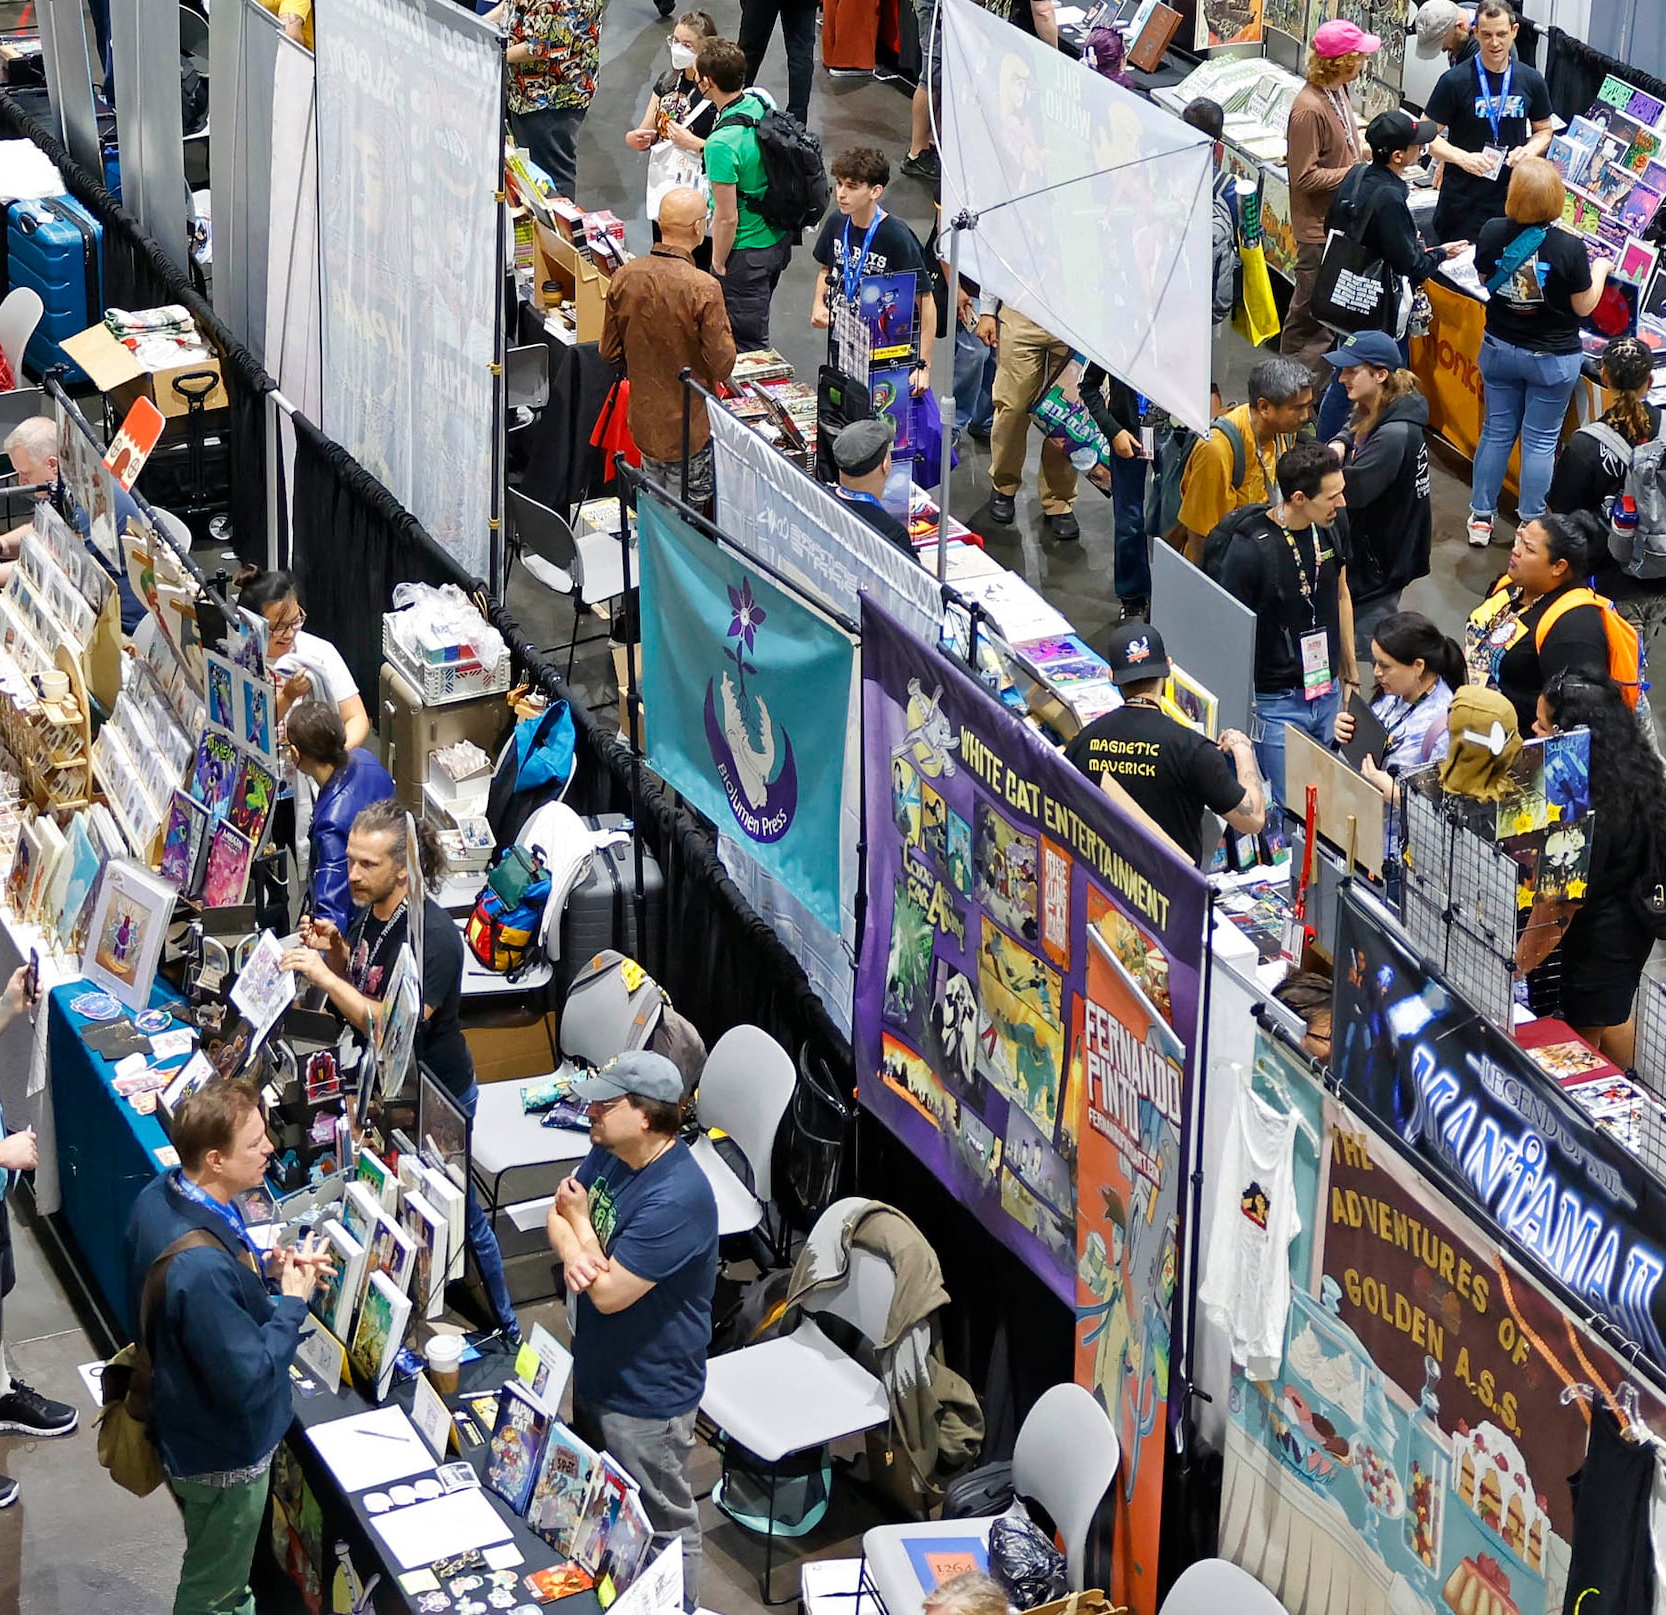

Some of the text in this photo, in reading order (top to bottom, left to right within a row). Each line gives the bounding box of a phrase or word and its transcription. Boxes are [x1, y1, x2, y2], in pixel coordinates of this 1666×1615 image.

[1089, 759, 1156, 777] MAVERICK
[1090, 737, 1159, 757] MAGNETIC
[717, 764, 787, 838] Biolumen Press
[960, 725, 1170, 930] WHITE CAT ENTERTAINMENT
[1084, 998, 1185, 1125] FERNANDO
[1331, 1123, 1373, 1175] THE
[1332, 1185, 1529, 1366] ADVENTURES OF
[1344, 1268, 1523, 1439] GOLDEN A.S.S.
[508, 1395, 537, 1422] ALPHA
[511, 1410, 532, 1432] CAT
